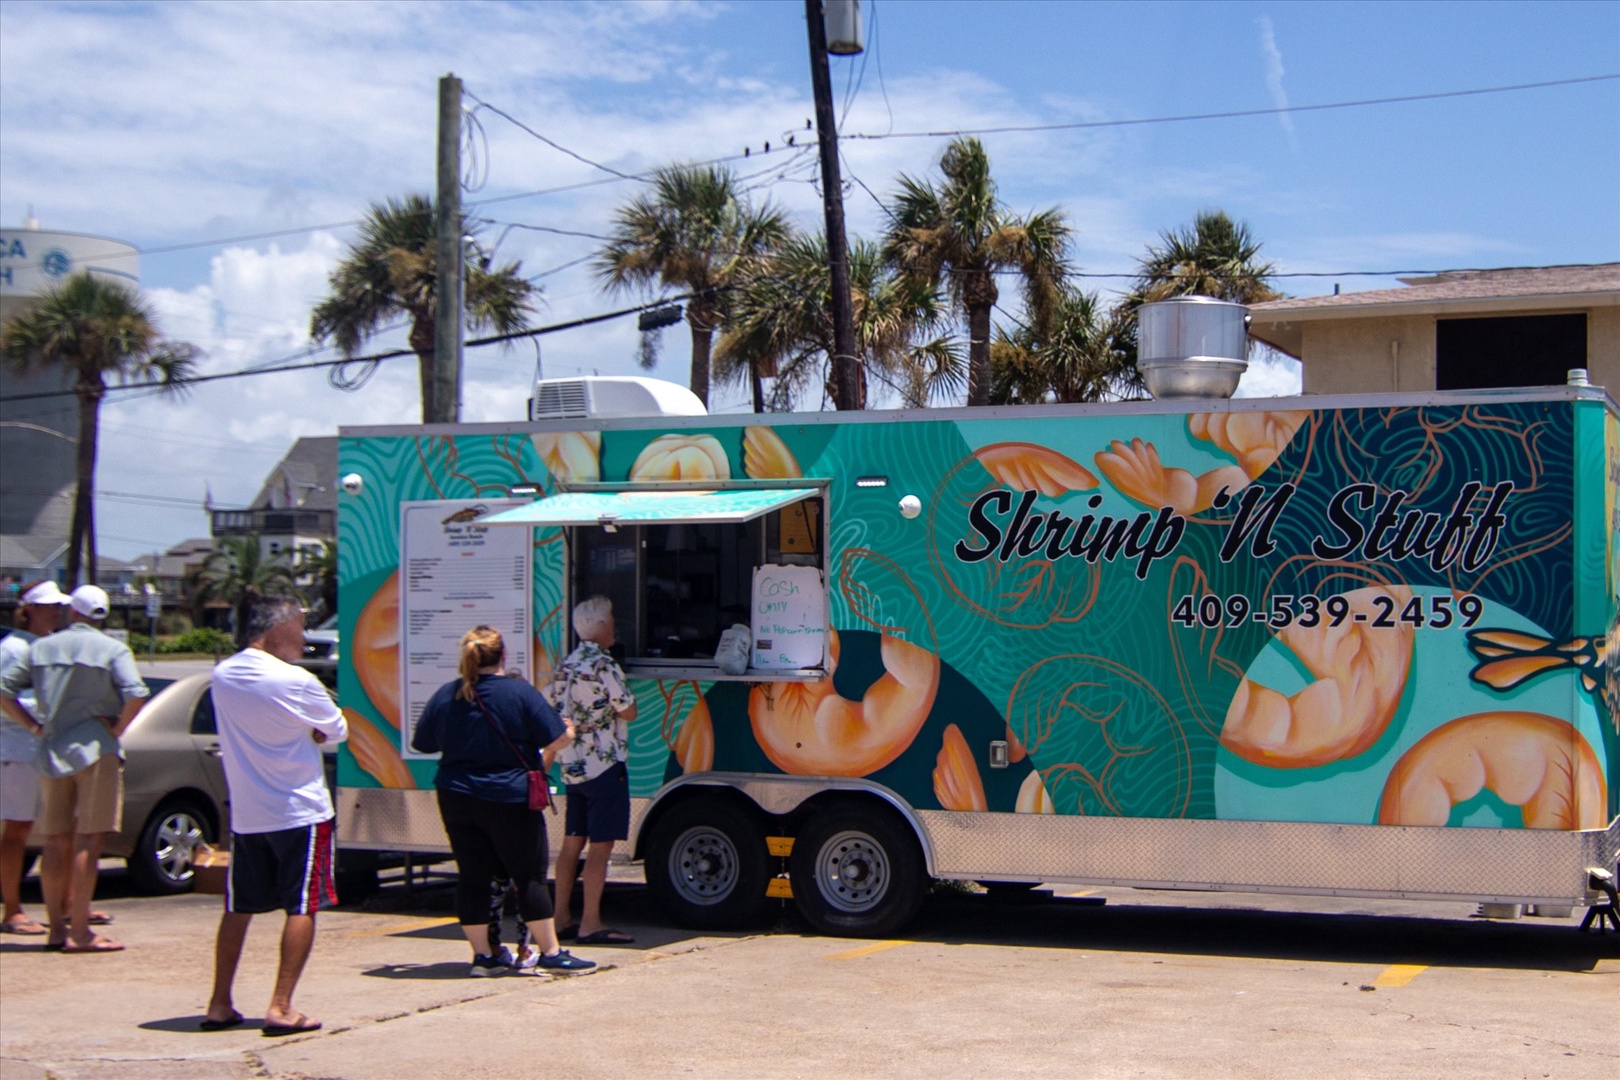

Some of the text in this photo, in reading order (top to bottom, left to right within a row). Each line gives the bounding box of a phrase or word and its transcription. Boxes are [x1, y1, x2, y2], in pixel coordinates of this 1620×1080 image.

[955, 489, 1186, 581] Shrimp
[1311, 480, 1515, 573] Stuff
[760, 576, 800, 598] Cash
[1171, 594, 1484, 629] 409-539-2459
